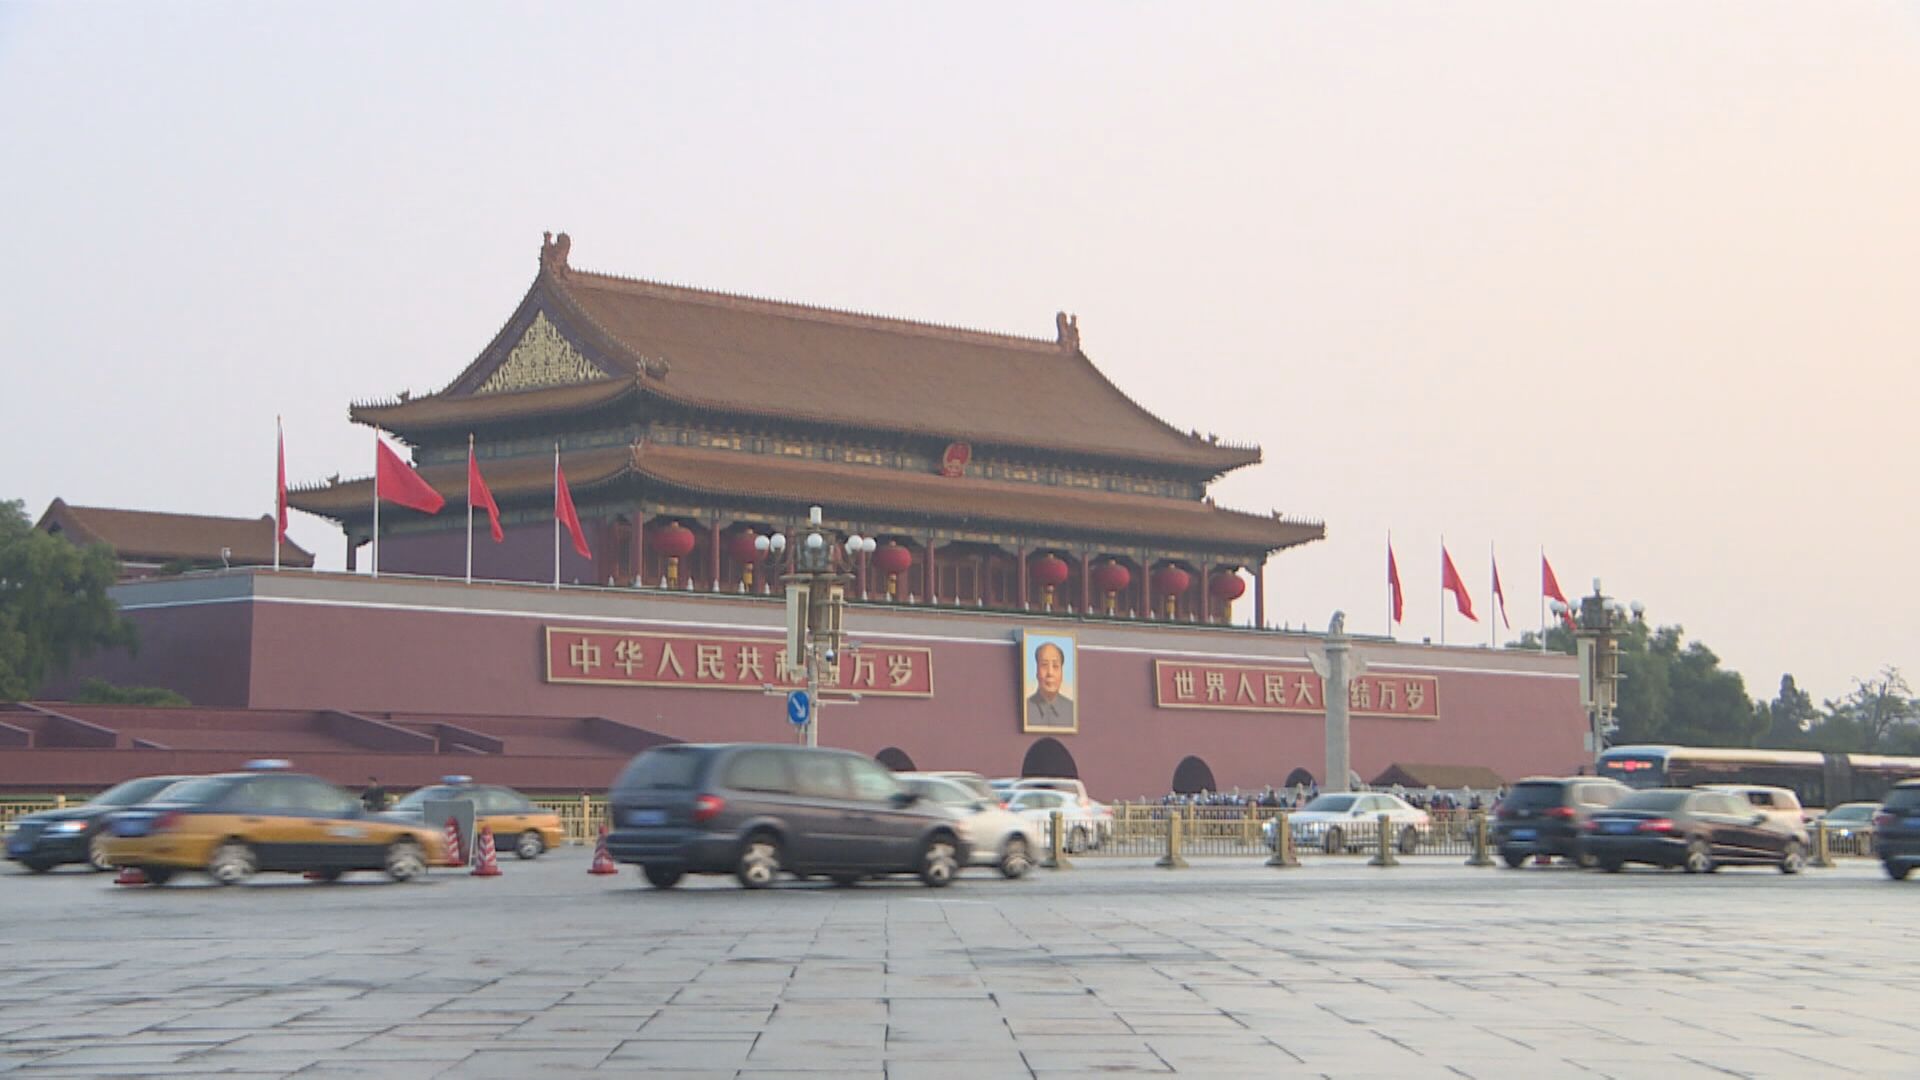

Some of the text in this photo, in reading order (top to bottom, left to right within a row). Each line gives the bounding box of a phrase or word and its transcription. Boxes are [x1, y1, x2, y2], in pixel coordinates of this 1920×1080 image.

[1174, 669, 1425, 710] 世界人民大结万岁
